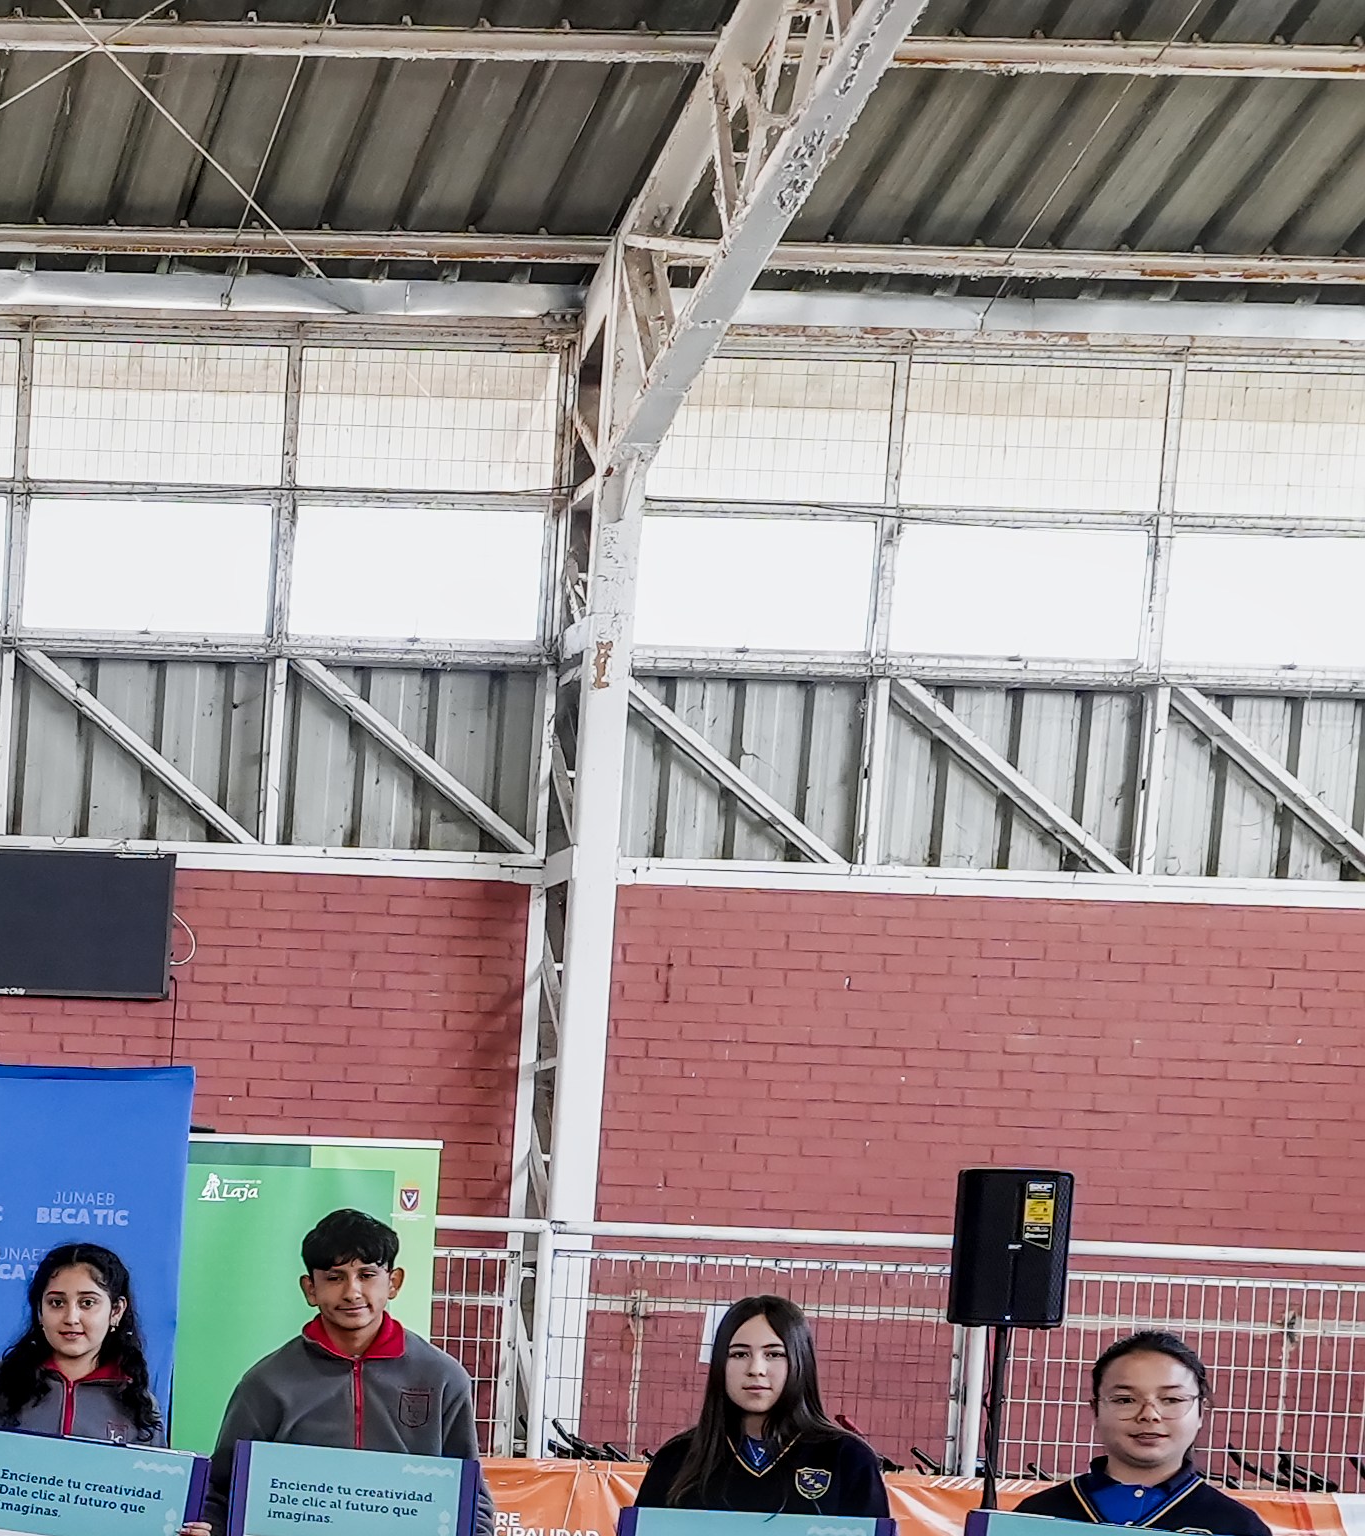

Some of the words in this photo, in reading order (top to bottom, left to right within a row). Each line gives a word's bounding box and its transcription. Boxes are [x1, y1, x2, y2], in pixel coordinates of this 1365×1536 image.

[53, 1192, 116, 1206] JUNAEB
[222, 1184, 259, 1202] Laja
[37, 1207, 91, 1224] BECA
[93, 1209, 130, 1226] TIC
[492, 1512, 521, 1527] RE
